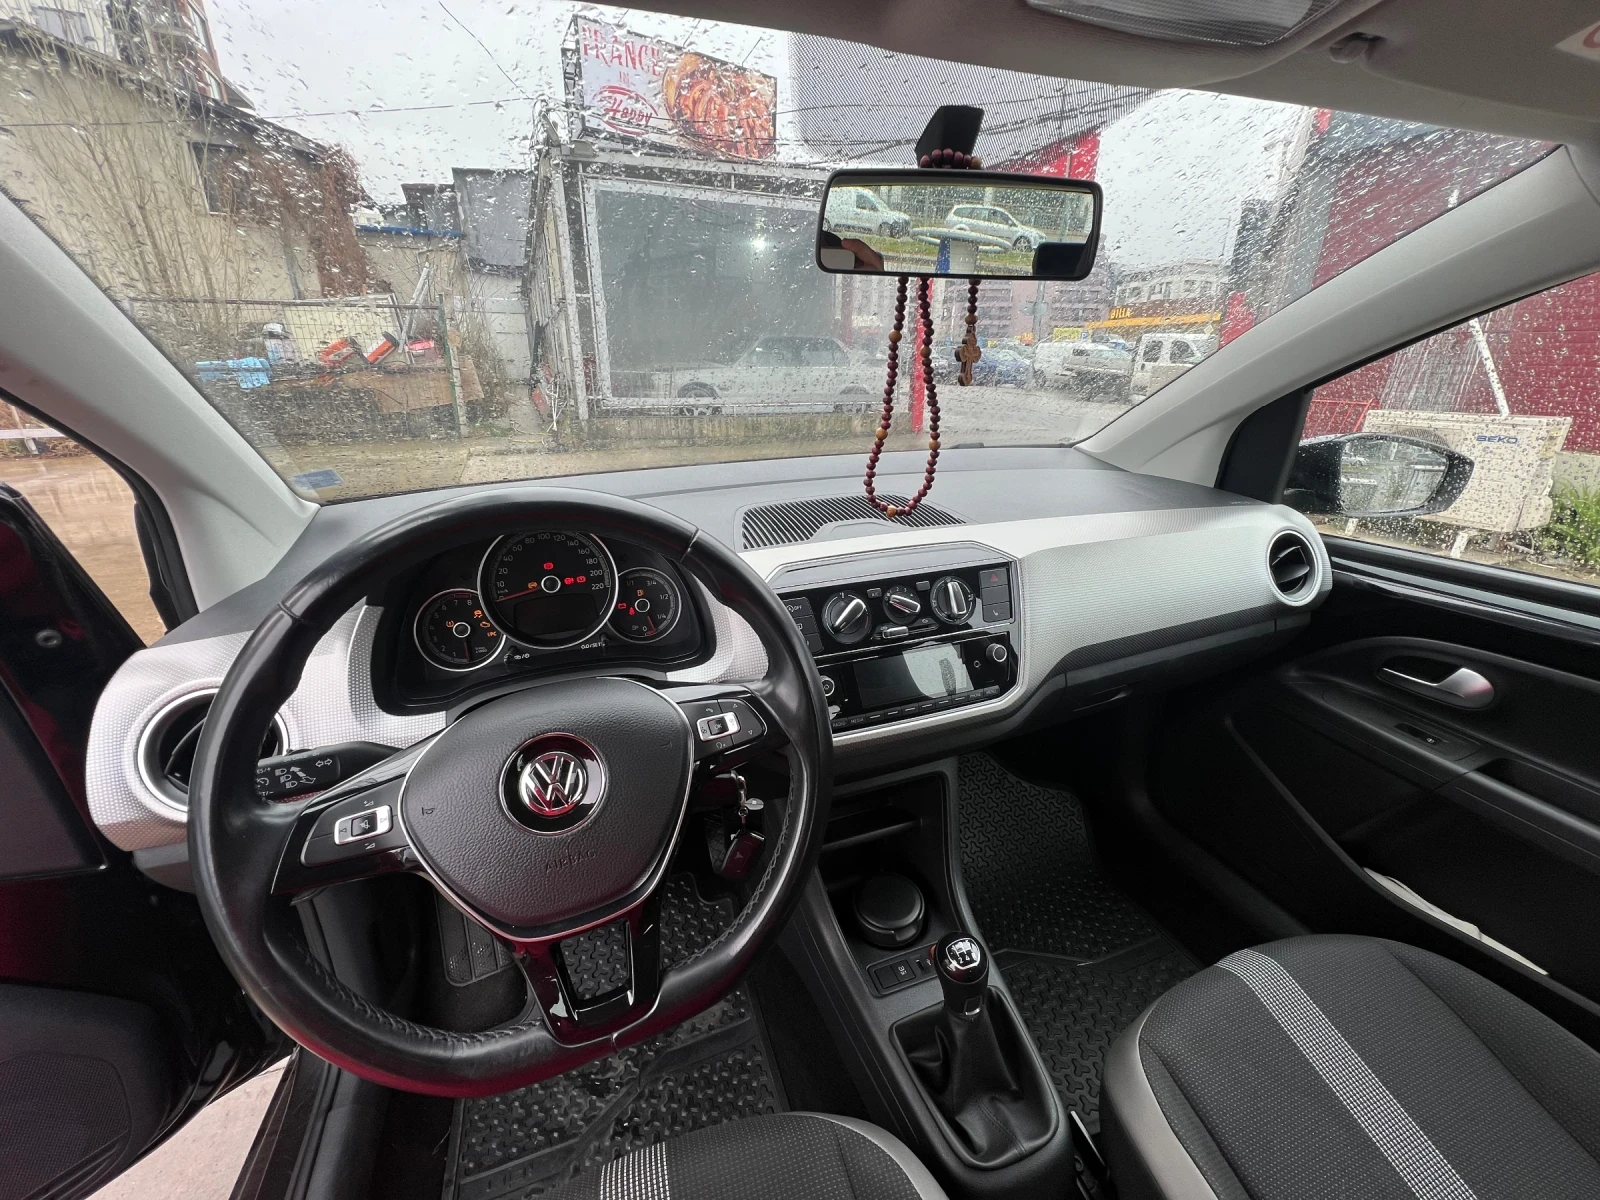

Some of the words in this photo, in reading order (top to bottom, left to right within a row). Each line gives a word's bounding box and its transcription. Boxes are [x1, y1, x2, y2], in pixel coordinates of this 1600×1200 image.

[602, 97, 653, 124] Happy
[1476, 435, 1518, 444] BEKO
[512, 544, 523, 552] 60
[578, 547, 590, 555] 160
[503, 554, 514, 562] 40
[585, 557, 598, 565] 180
[498, 567, 508, 575] 20
[589, 569, 603, 577] 200
[496, 580, 505, 588] 10
[832, 720, 847, 728] RADIO
[545, 848, 597, 872] AIRBAG
